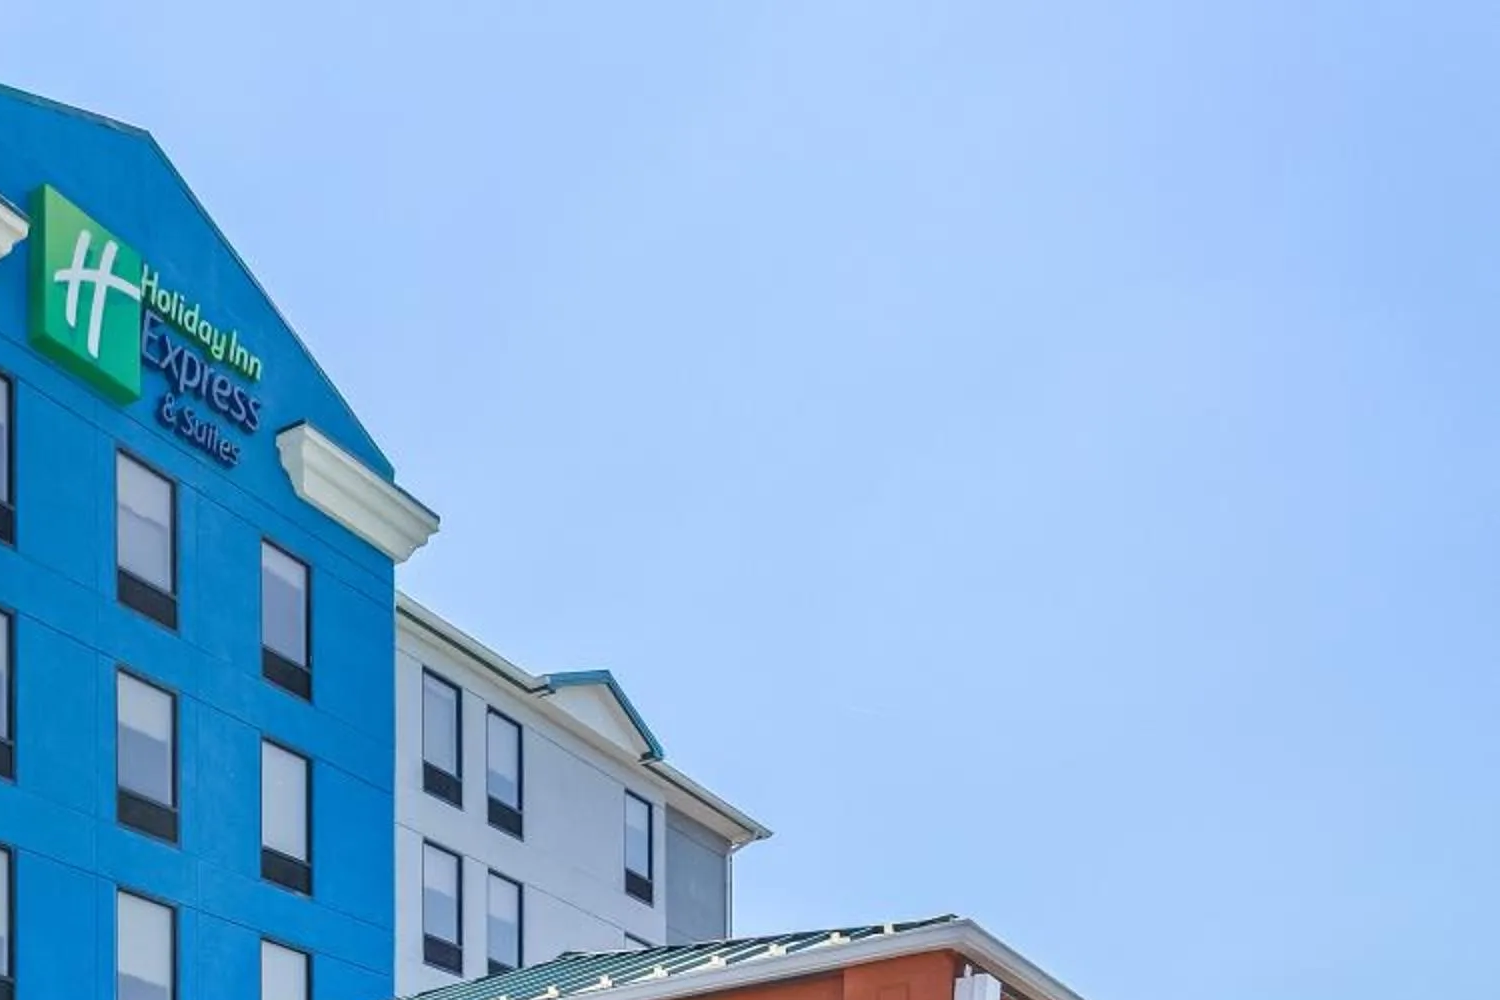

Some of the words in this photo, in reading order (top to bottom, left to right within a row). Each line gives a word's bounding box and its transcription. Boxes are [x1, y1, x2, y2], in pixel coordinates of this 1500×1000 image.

[141, 264, 227, 360] Holiday
[229, 328, 263, 381] Inn
[142, 309, 262, 431] Express
[162, 391, 177, 425] &
[181, 406, 240, 465] Suites
